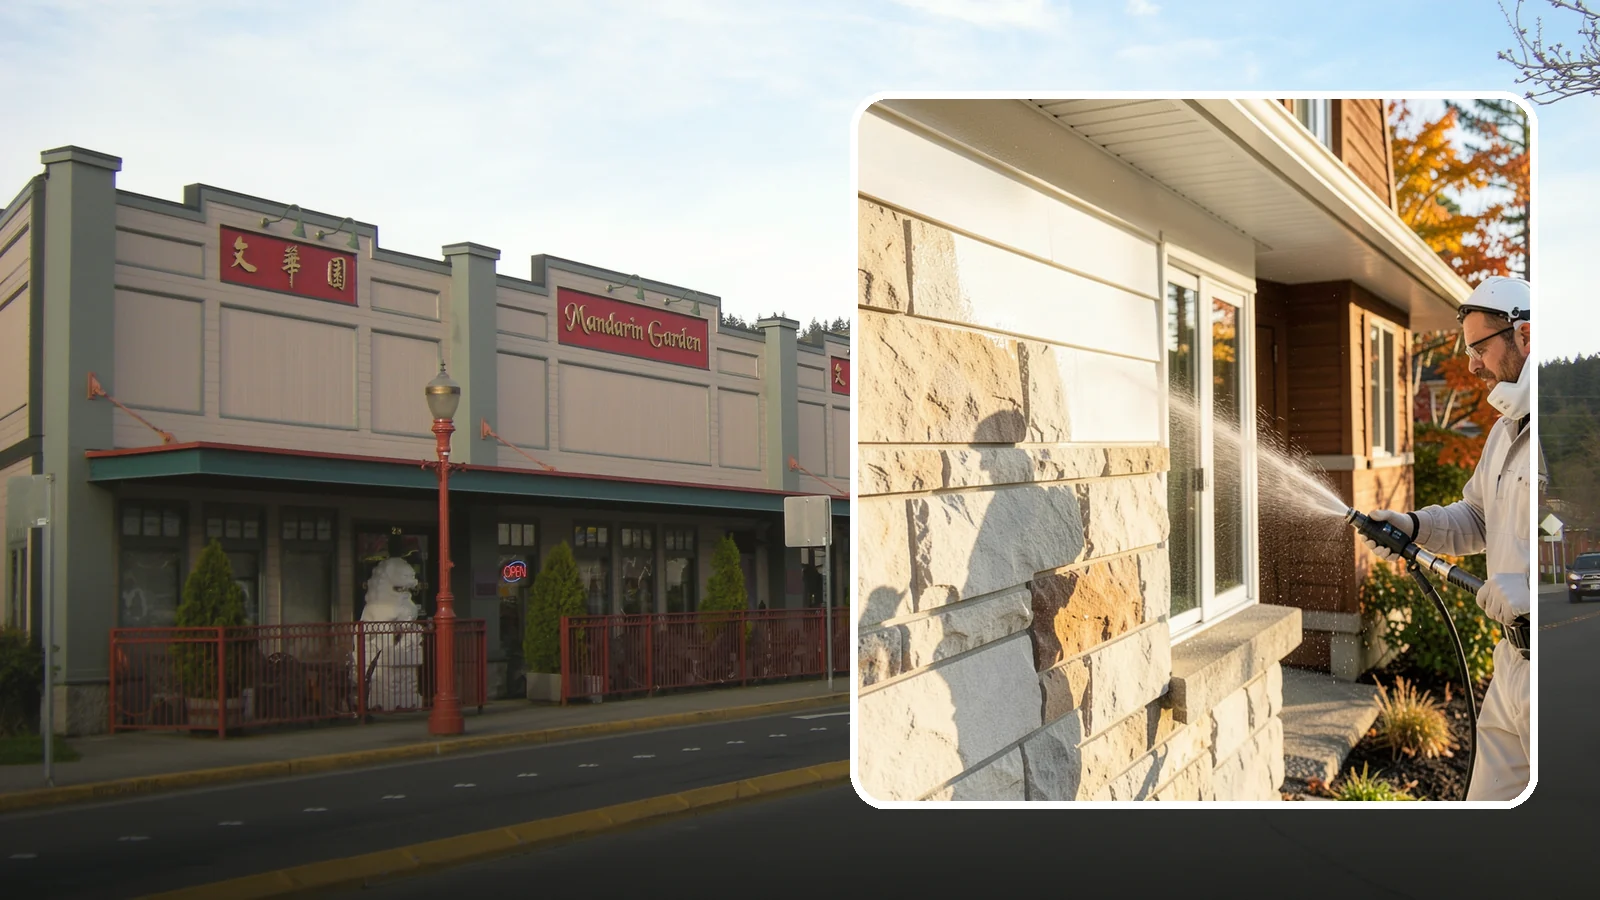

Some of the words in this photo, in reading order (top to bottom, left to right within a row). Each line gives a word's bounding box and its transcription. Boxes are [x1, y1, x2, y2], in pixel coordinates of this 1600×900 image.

[564, 301, 644, 342] Mandarin
[648, 319, 702, 352] Garden
[503, 565, 527, 578] OPEN
